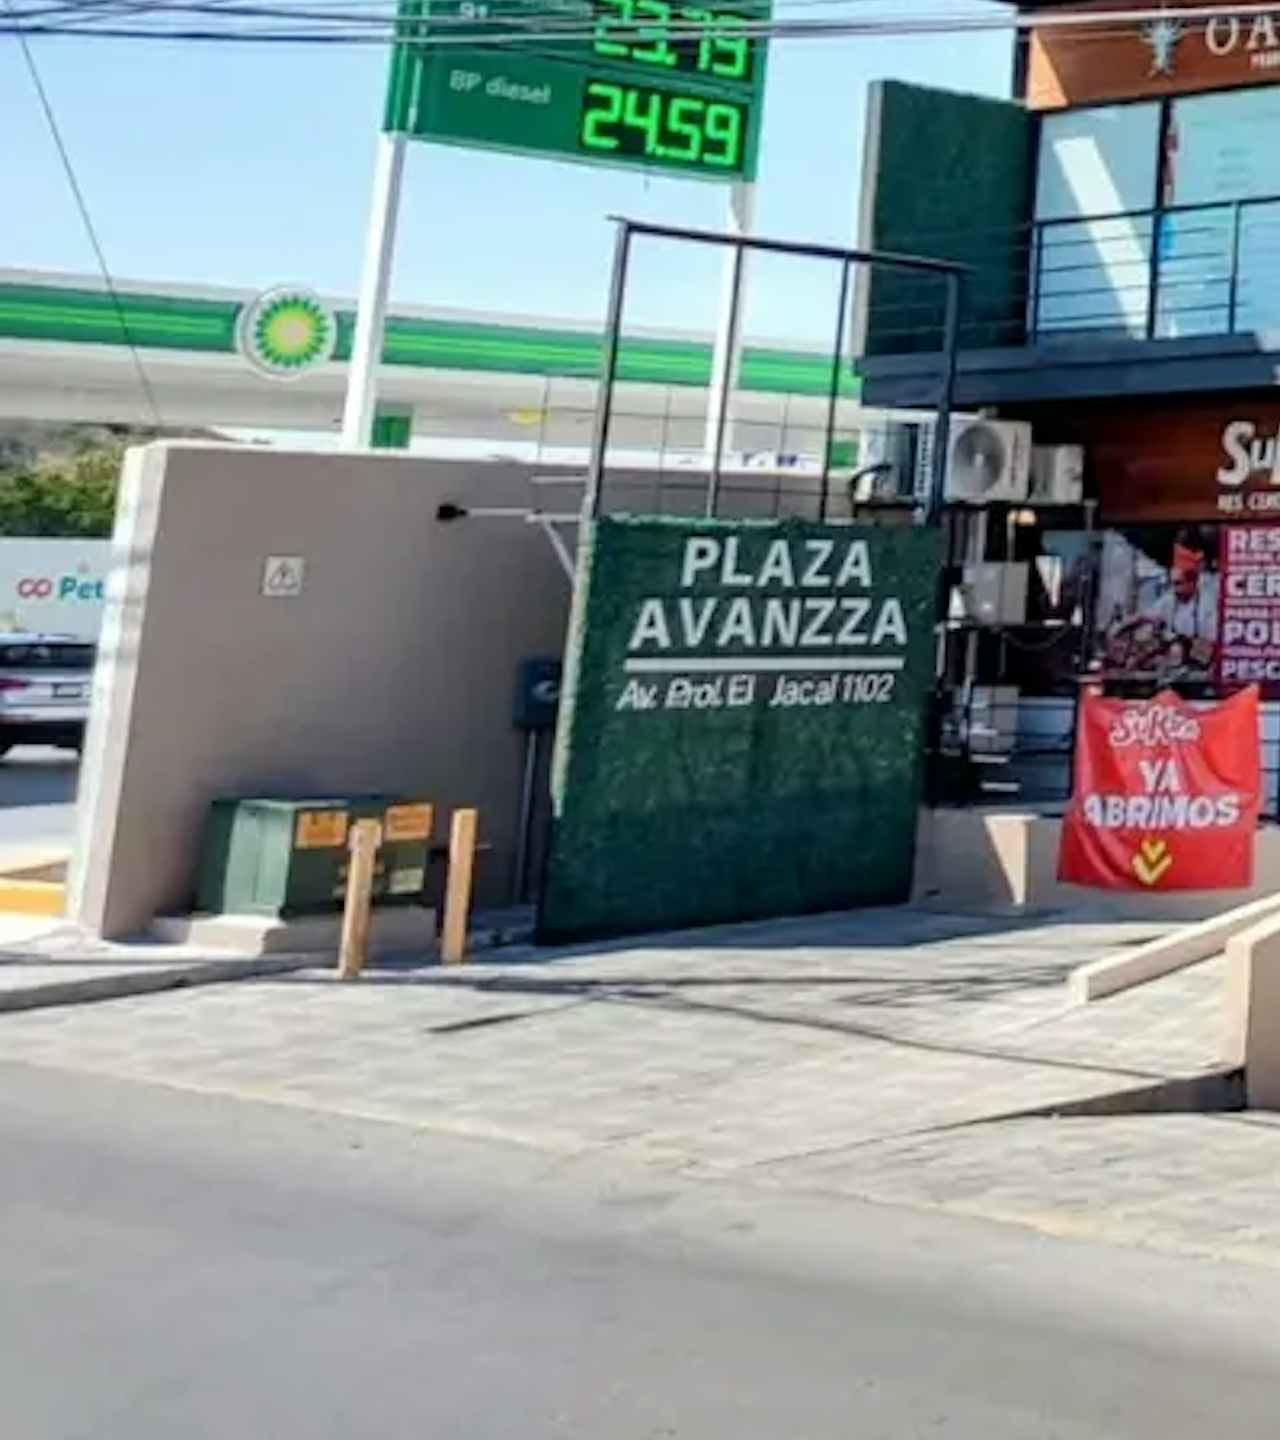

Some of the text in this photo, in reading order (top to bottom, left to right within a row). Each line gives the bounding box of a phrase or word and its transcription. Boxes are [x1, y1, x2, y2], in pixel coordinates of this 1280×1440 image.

[450, 69, 741, 166] BP diesel 24.59
[681, 536, 873, 588] PLAZA
[628, 597, 908, 651] AVANZZA
[769, 671, 839, 707] Jacal
[842, 671, 895, 704] 1102
[1138, 759, 1180, 792] YA
[1083, 792, 1240, 831] ABRIMOS
